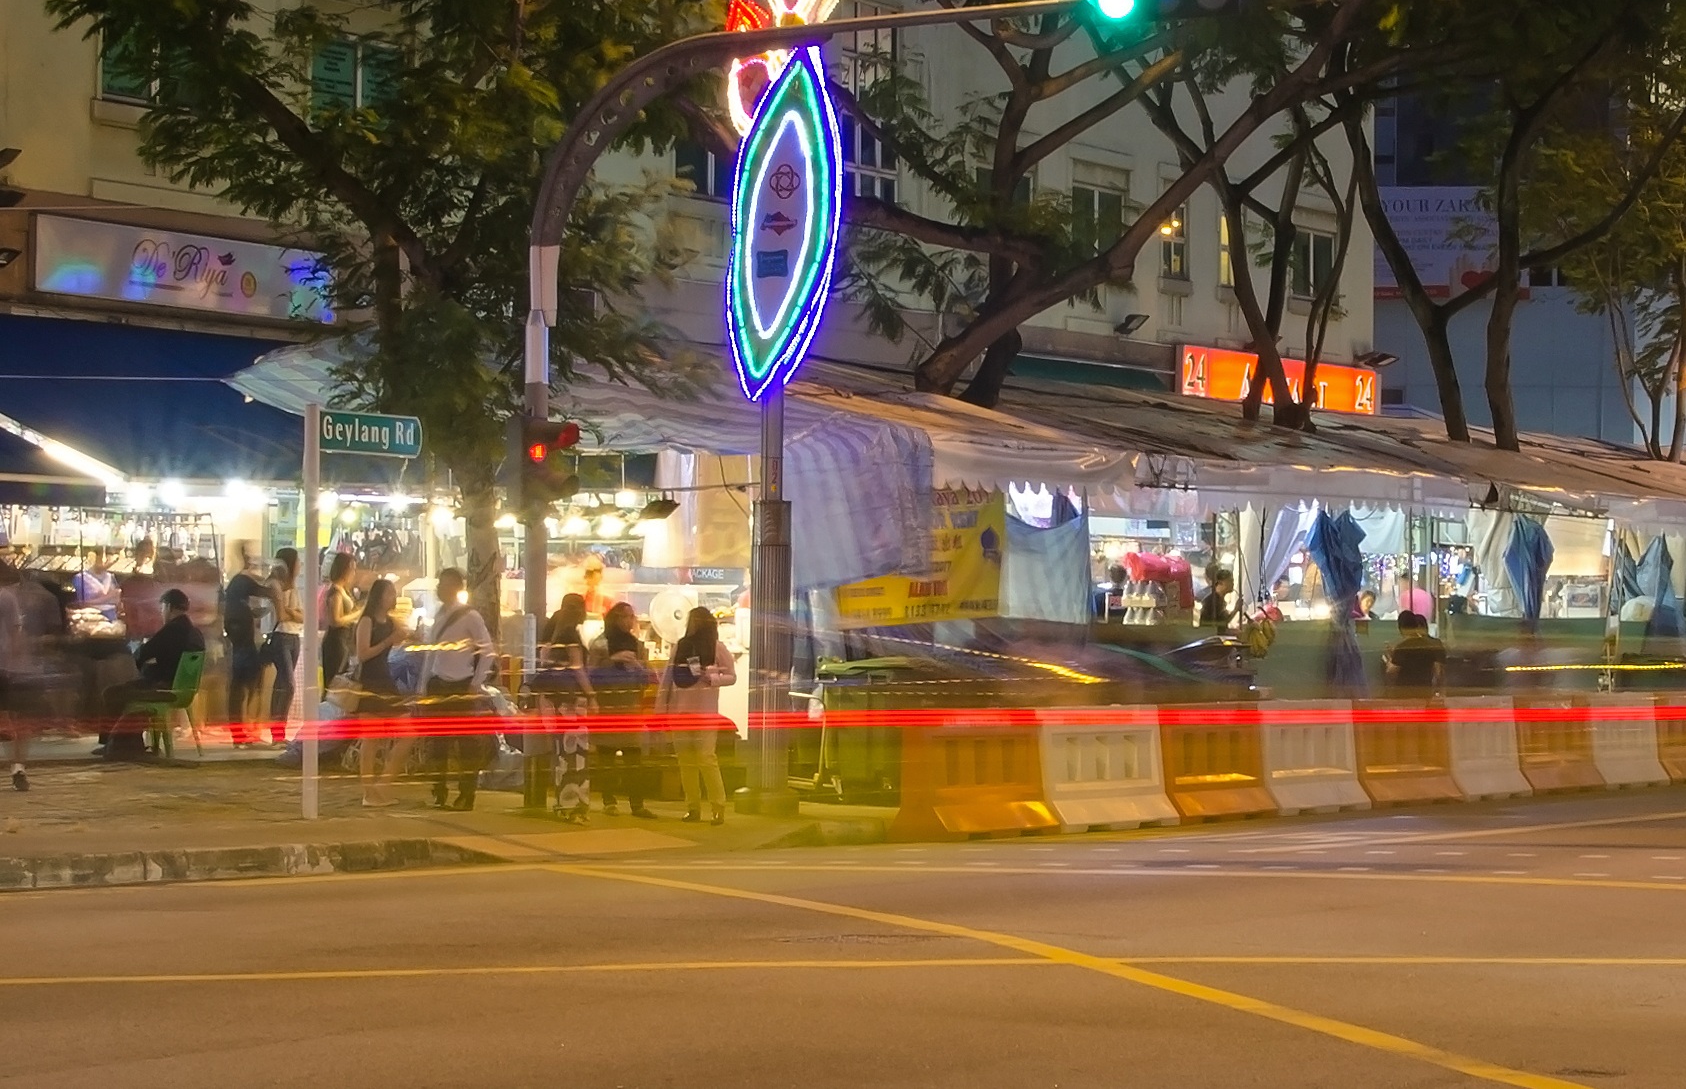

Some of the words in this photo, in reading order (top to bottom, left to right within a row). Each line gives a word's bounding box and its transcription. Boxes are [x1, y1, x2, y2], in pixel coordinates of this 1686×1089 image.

[1436, 198, 1482, 213] ZAK
[1185, 352, 1206, 391] 24
[1354, 374, 1374, 410] 24
[323, 415, 389, 450] Geylang
[395, 421, 414, 446] Rd
[691, 568, 724, 580] ACKAGE
